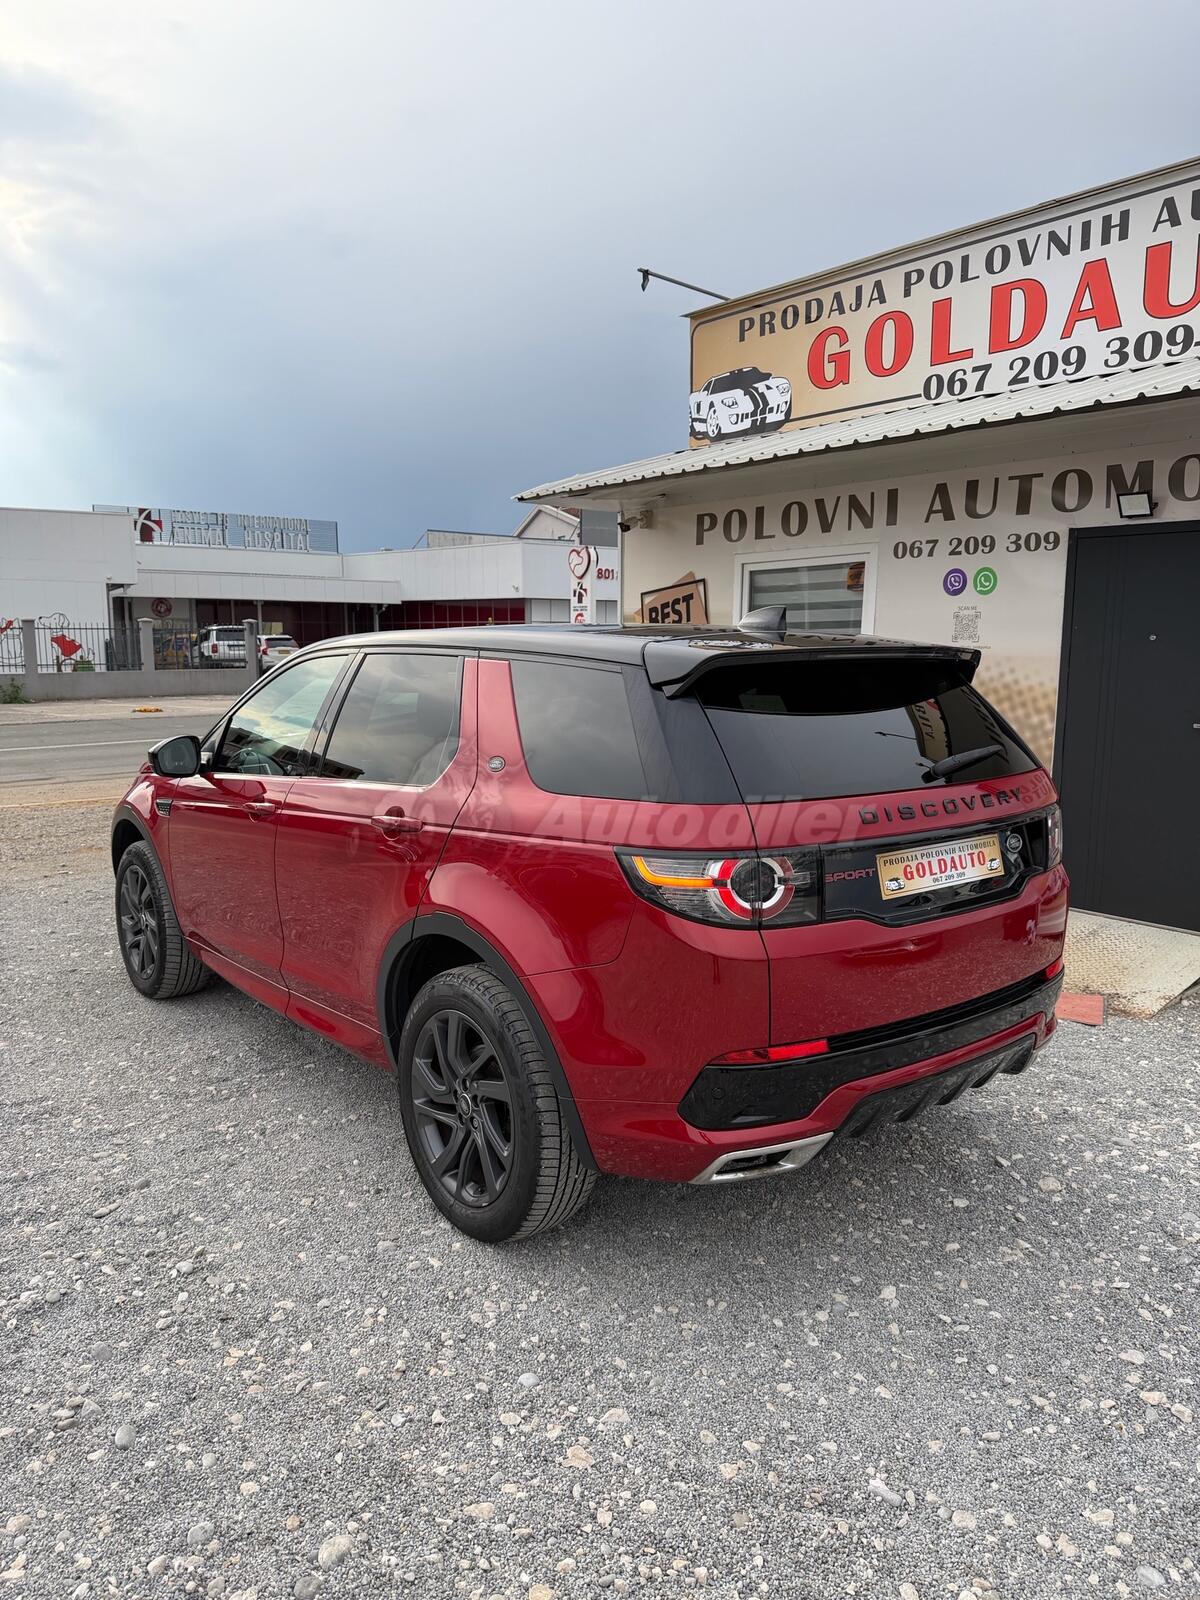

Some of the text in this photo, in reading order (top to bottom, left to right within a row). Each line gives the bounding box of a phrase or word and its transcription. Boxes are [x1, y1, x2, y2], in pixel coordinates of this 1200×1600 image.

[738, 279, 887, 343] PRODAJA
[903, 208, 1131, 299] POLOVNIH
[922, 324, 1195, 401] 067 209 309
[238, 514, 312, 531] INTERNATIONAL
[695, 487, 899, 546] POLOVNI
[173, 527, 311, 551] ANIMAL HOSPITAL
[892, 530, 1061, 560] 067 209 309
[648, 592, 694, 624] BEST
[859, 786, 1022, 825] DISCOVERY
[883, 854, 919, 867] PRODAJA
[920, 847, 957, 861] POLOVNIH
[958, 840, 997, 854] AUTOMOBILA
[903, 850, 986, 881] GOLDAUTO
[824, 866, 876, 883] SPORT
[932, 871, 966, 884] 067 209 309
